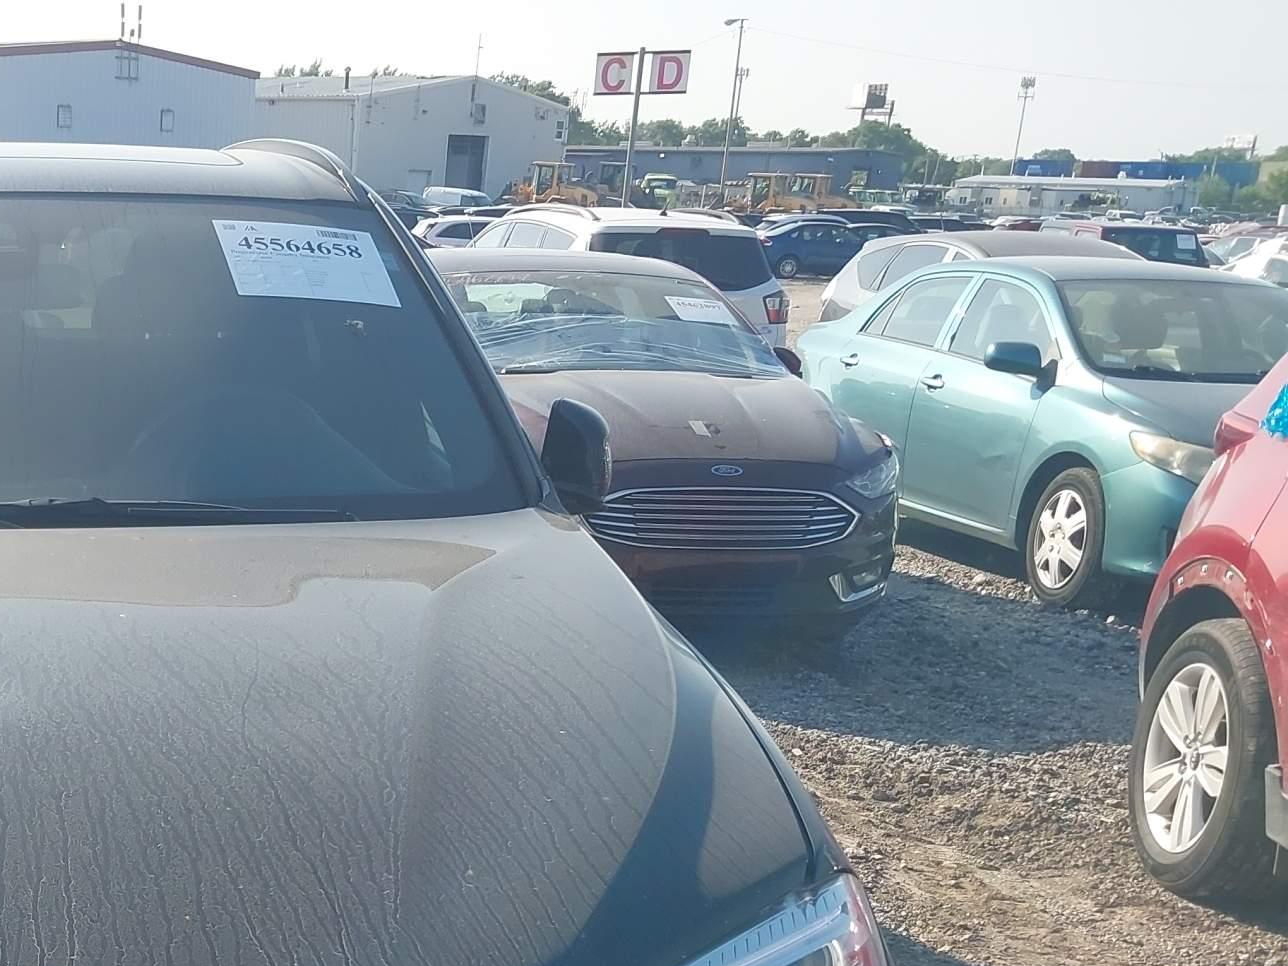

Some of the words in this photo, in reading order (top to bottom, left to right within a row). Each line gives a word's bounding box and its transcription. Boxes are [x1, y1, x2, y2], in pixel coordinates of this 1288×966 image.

[601, 57, 627, 92] C
[656, 55, 683, 90] D
[238, 236, 362, 259] 45564658
